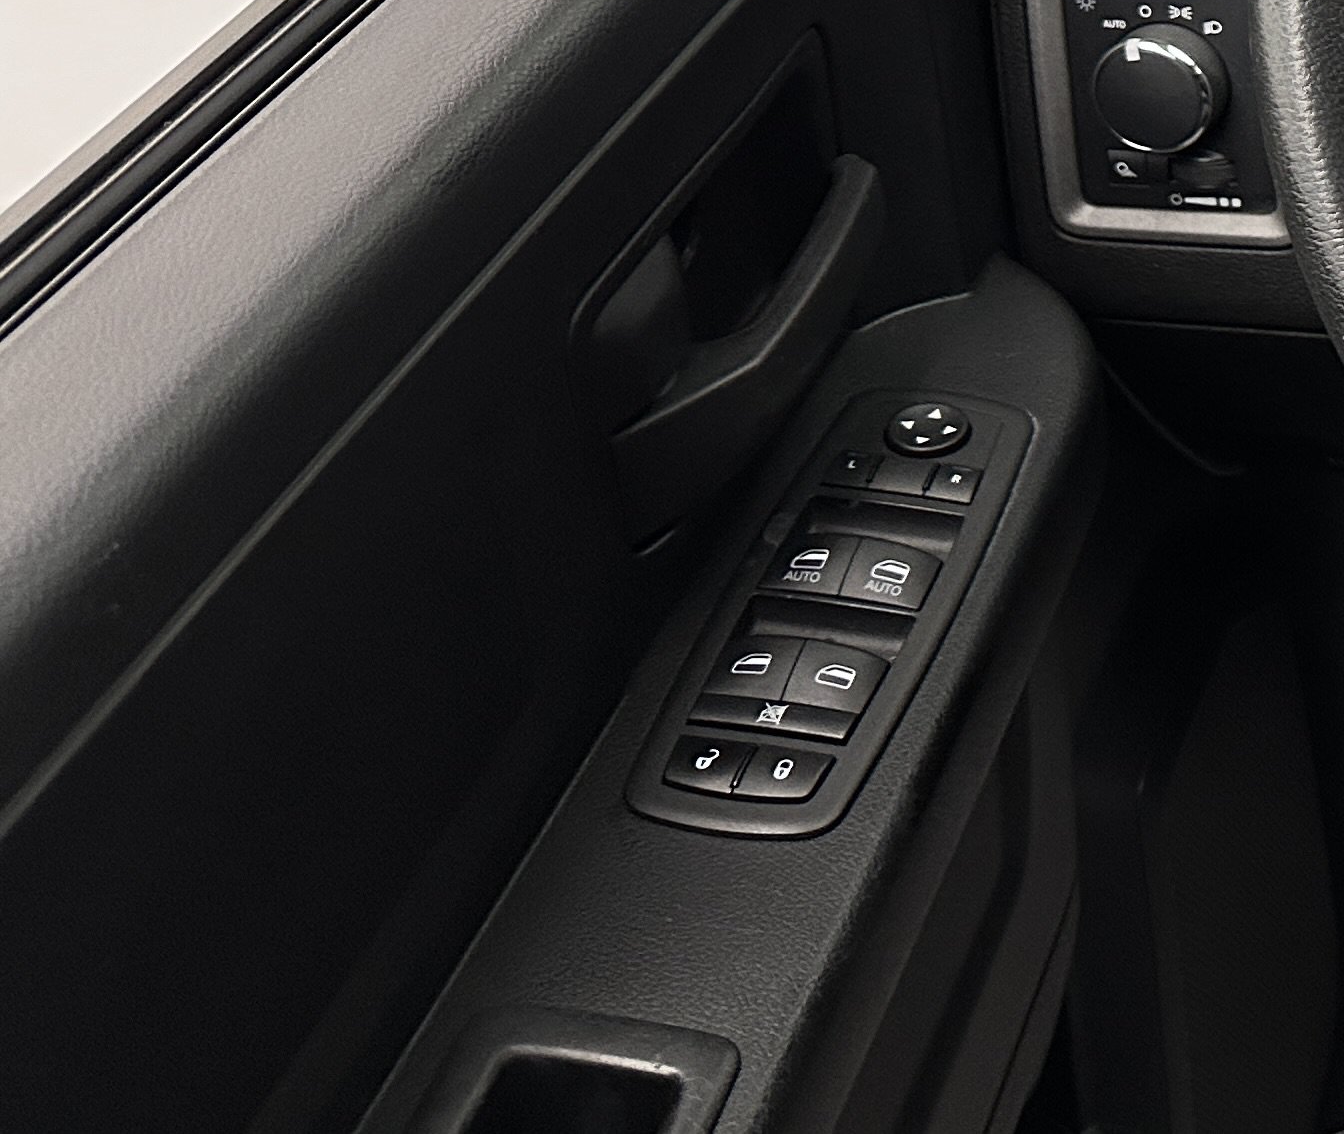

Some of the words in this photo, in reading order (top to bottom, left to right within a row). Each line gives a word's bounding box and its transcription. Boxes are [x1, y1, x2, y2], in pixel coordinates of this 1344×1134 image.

[1102, 18, 1127, 30] AUTO
[783, 569, 823, 584] AUTO
[864, 579, 902, 596] AUTO
